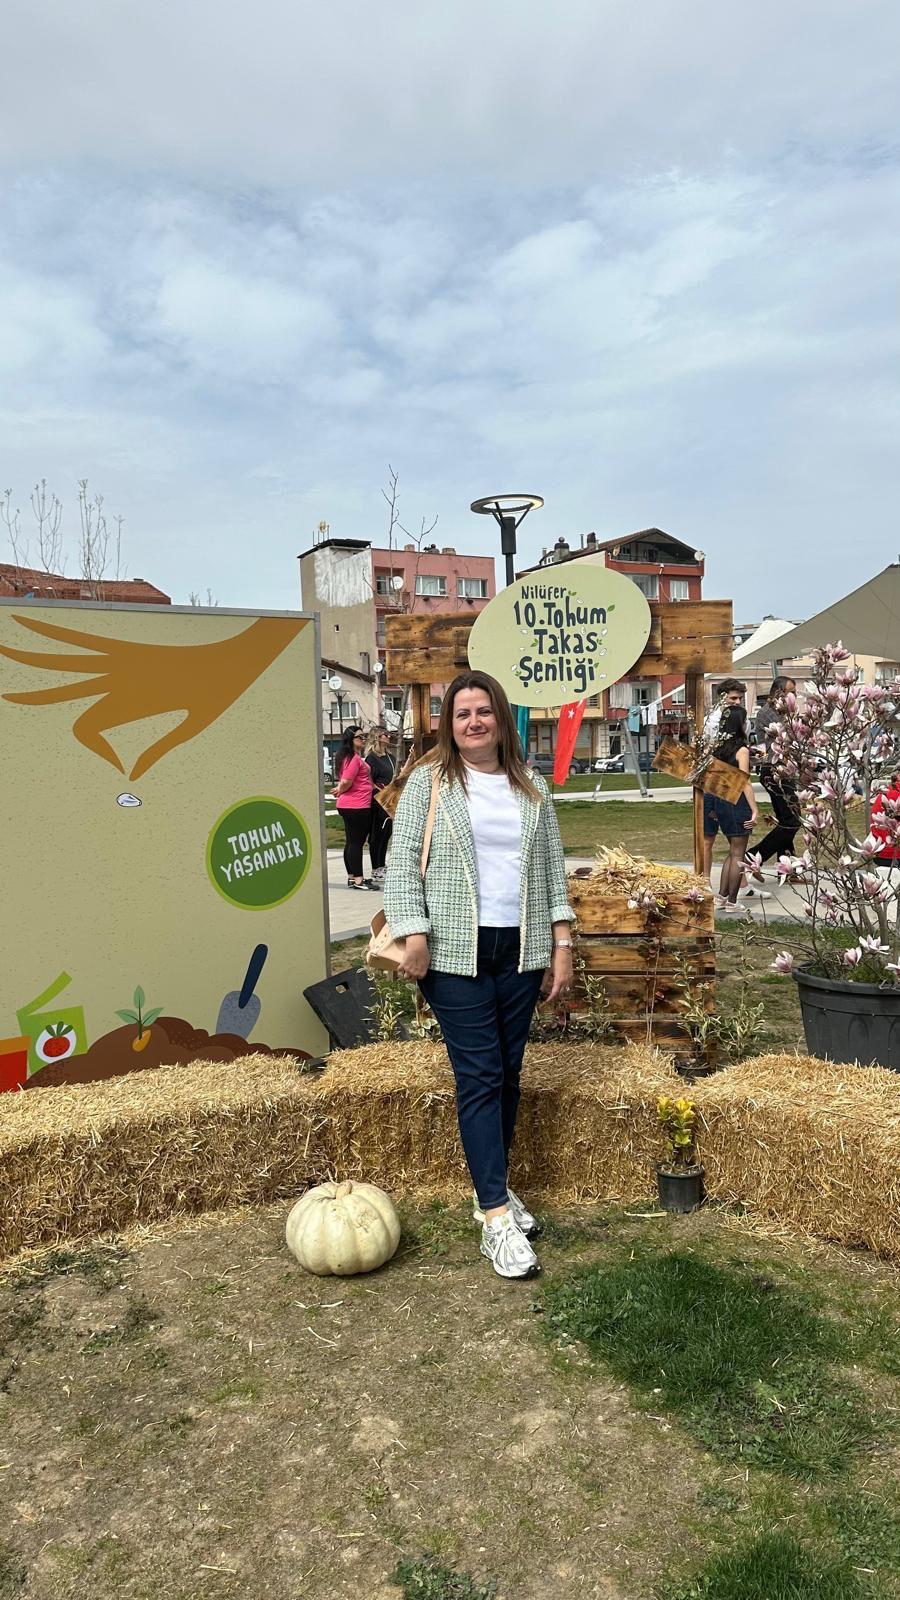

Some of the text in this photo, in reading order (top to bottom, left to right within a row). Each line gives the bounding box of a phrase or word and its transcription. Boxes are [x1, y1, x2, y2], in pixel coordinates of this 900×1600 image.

[521, 585, 567, 600] Nilüfer
[533, 628, 598, 655] Takas
[519, 656, 595, 693] Şenliği
[227, 821, 286, 855] TOHUM
[220, 837, 304, 883] YAŞAMDIR
